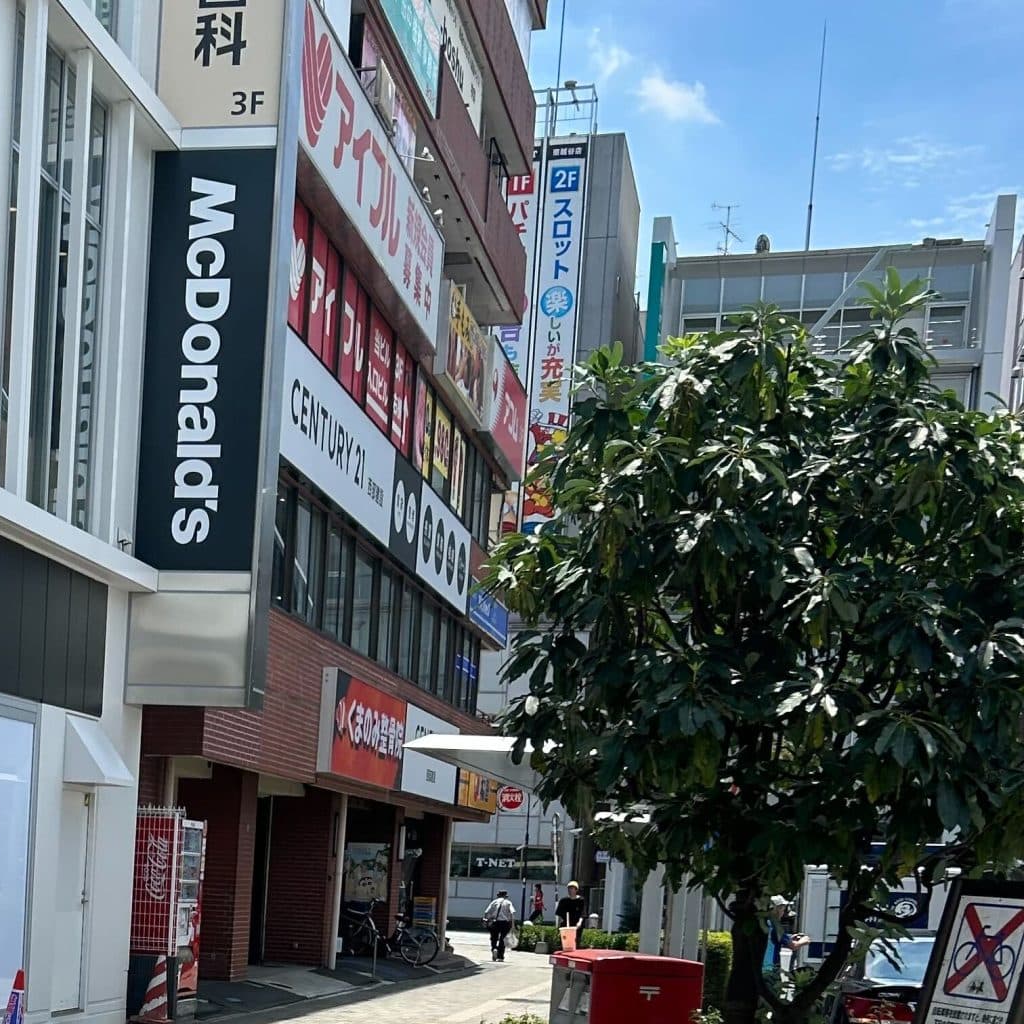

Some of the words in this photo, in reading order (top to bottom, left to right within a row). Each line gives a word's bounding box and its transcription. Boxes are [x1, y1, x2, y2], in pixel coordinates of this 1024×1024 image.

[194, 0, 247, 67] 科
[230, 90, 265, 116] 3F
[333, 70, 401, 257] アイフル
[512, 175, 531, 192] 1F
[554, 169, 577, 189] 2F
[552, 198, 574, 280] スロット
[310, 256, 364, 373] アイフル
[170, 176, 237, 546] McDonald's
[291, 378, 354, 475] CENTURY
[354, 444, 366, 489] 21
[347, 698, 406, 761] くまのみ整骨院
[476, 857, 516, 869] T-NET
